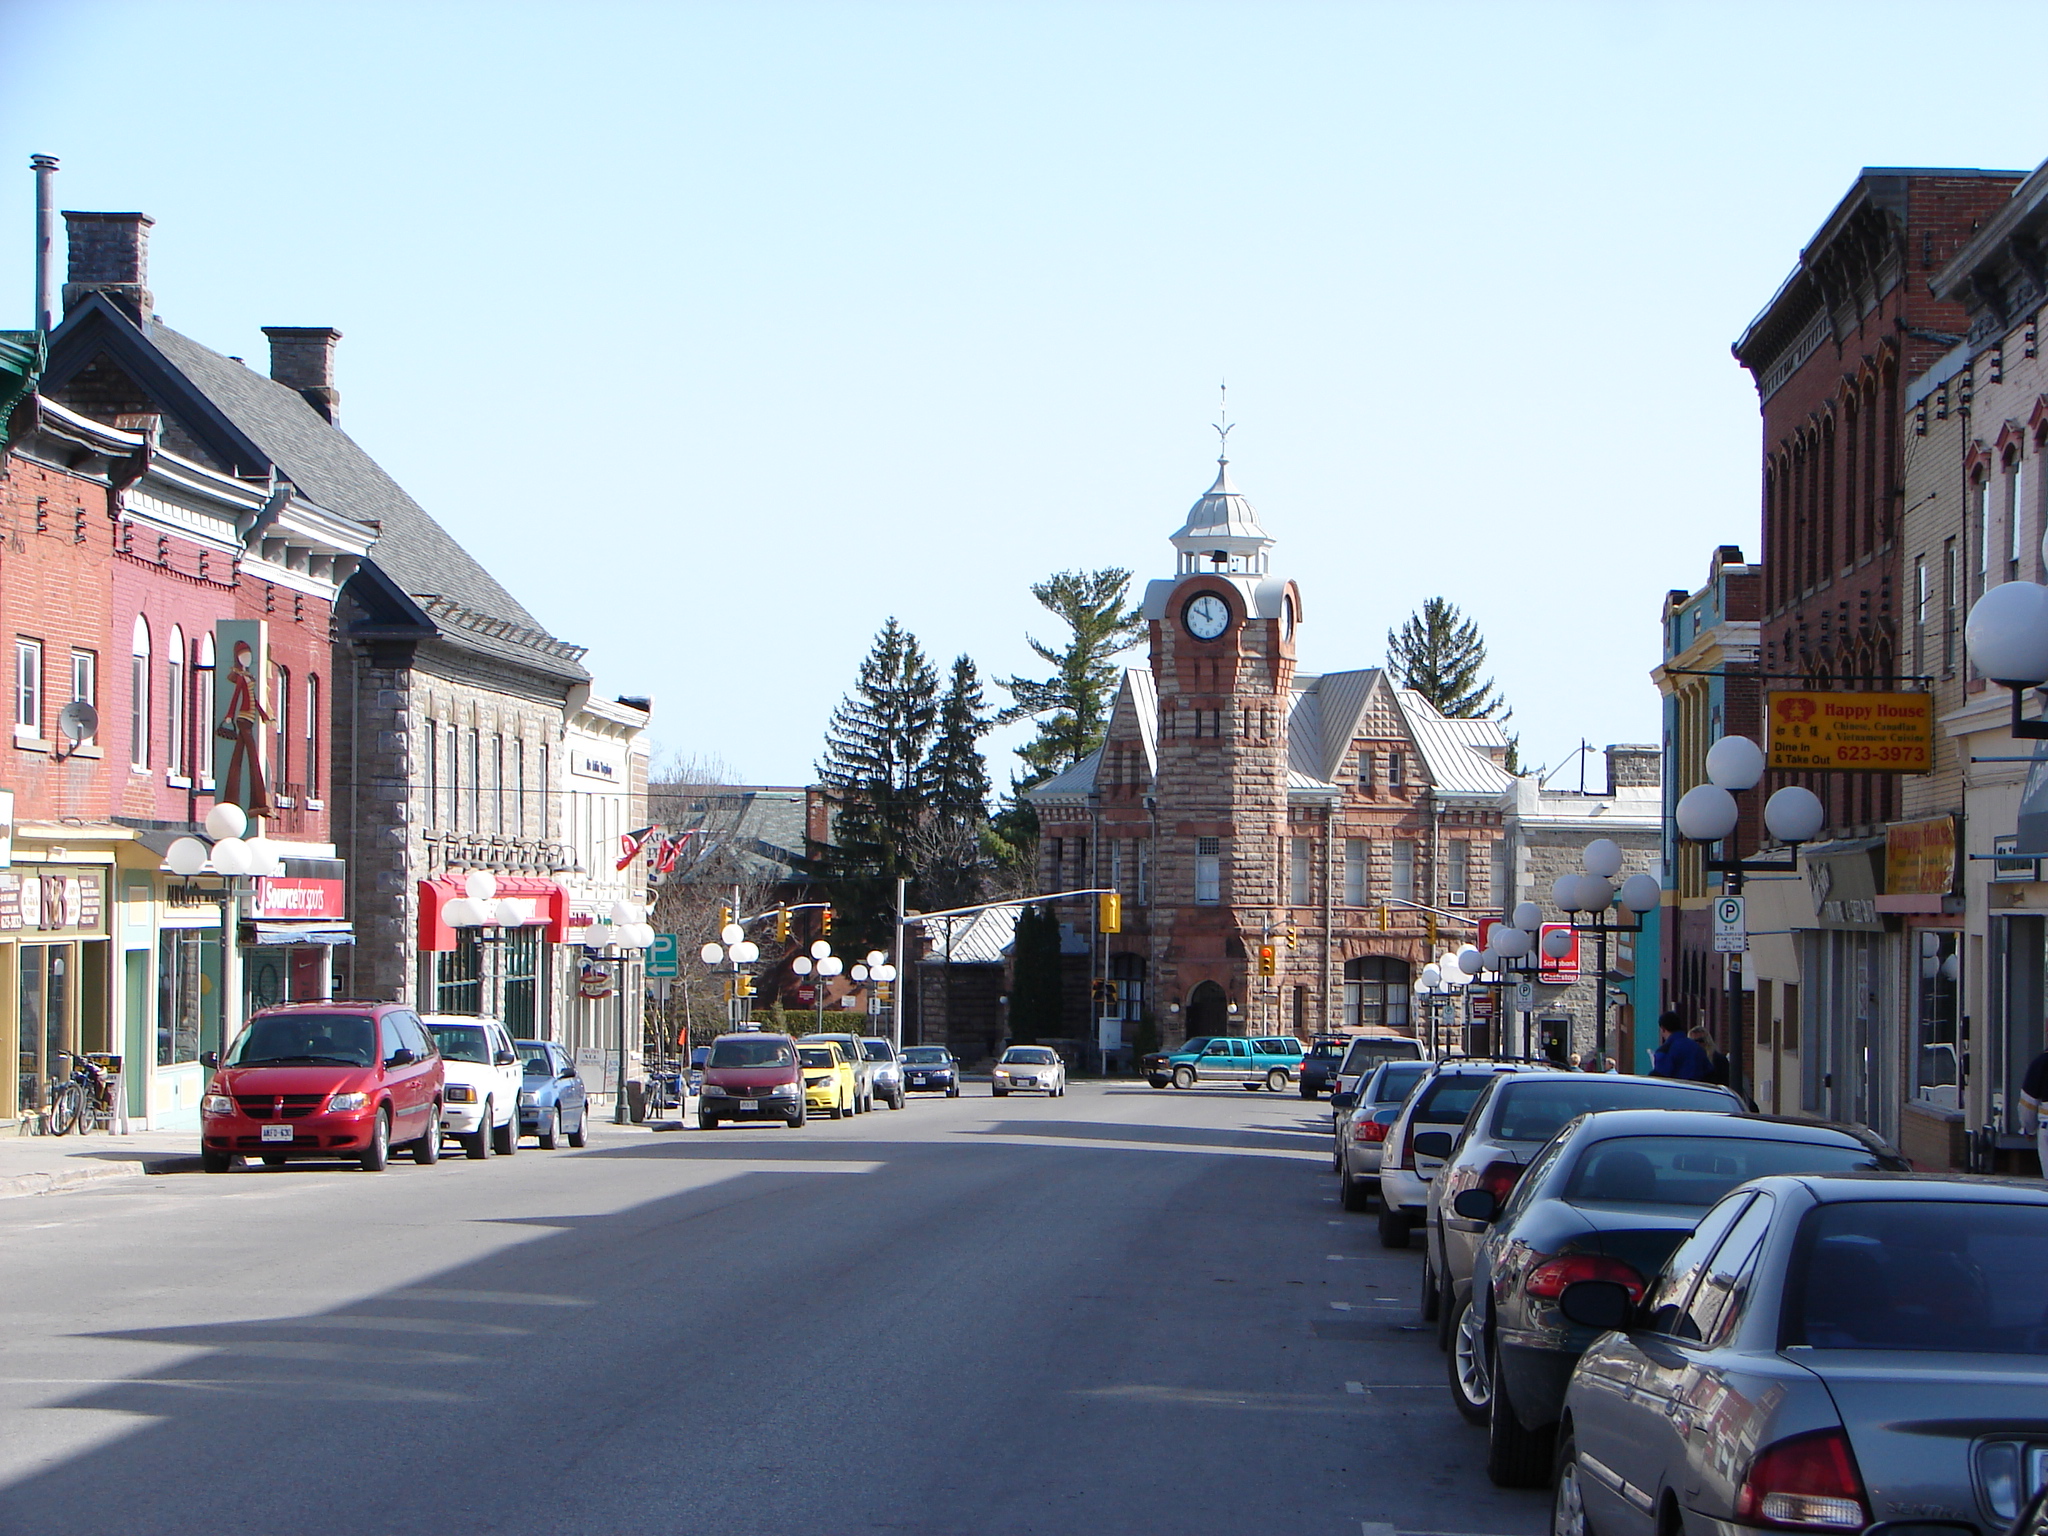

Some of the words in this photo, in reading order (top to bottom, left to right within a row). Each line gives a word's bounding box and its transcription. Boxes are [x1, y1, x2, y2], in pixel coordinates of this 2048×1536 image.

[1825, 703, 1872, 720] Happy
[1877, 704, 1925, 718] House
[1833, 721, 1871, 732] Chinese,
[1874, 722, 1917, 732] Canadian
[1825, 732, 1832, 741] &
[1836, 732, 1886, 742] Vietnamese
[1890, 733, 1925, 742] Cuisine
[1774, 742, 1798, 752] Dine
[1800, 742, 1811, 752] In
[1775, 754, 1783, 764] &
[1785, 754, 1809, 765] Take
[1811, 755, 1830, 766] Out
[1837, 746, 1925, 762] 623-3973
[266, 881, 297, 909] Source
[305, 884, 324, 917] sports
[651, 936, 672, 962] P
[1543, 959, 1577, 967] Scotabank
